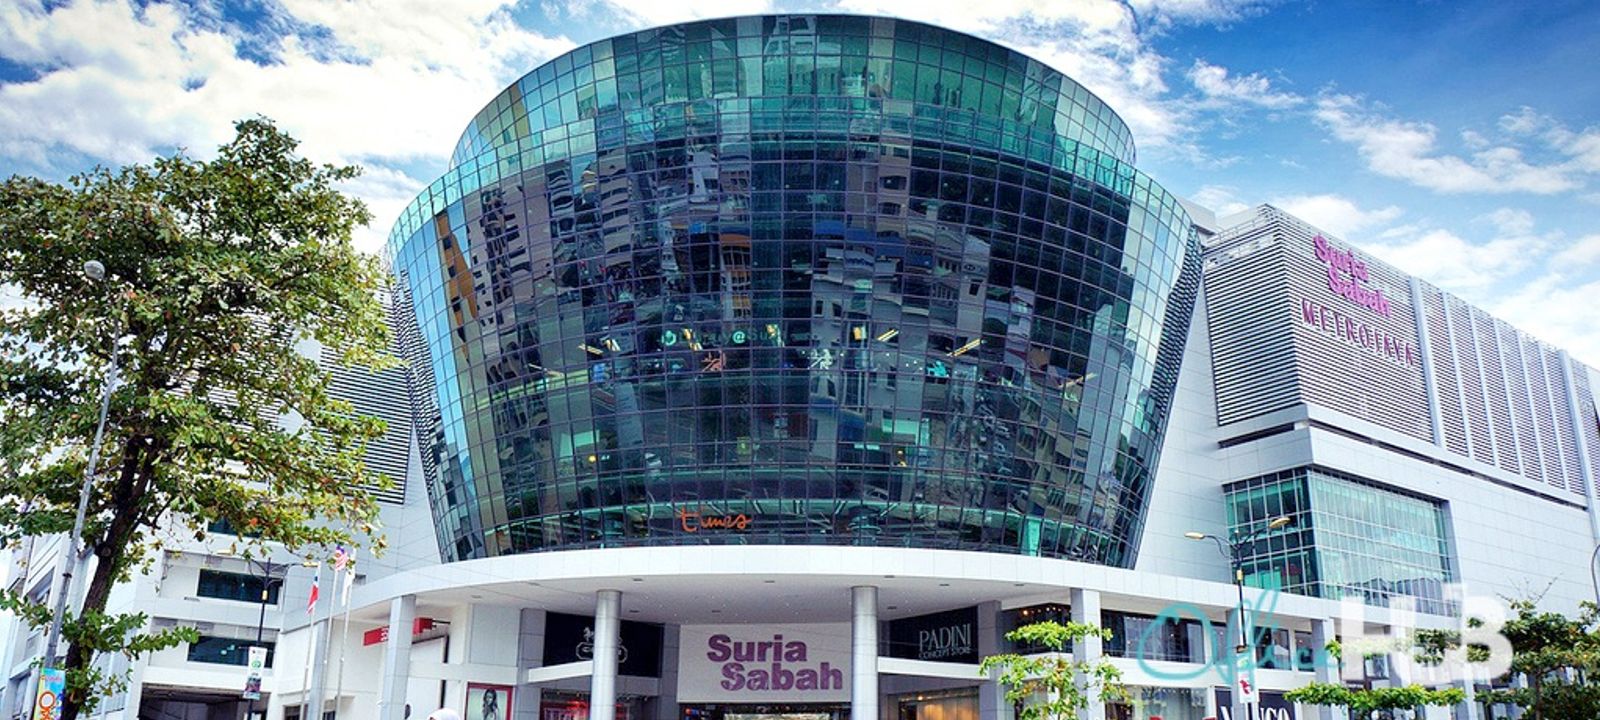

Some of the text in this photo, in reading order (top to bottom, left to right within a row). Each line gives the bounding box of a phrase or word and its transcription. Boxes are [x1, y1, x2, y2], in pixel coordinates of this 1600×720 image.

[1312, 233, 1369, 283] Suria
[1327, 265, 1392, 318] Sabah
[676, 505, 753, 532] times
[706, 634, 808, 662] Suria
[919, 623, 971, 653] PADINI
[720, 662, 843, 691] Sabah
